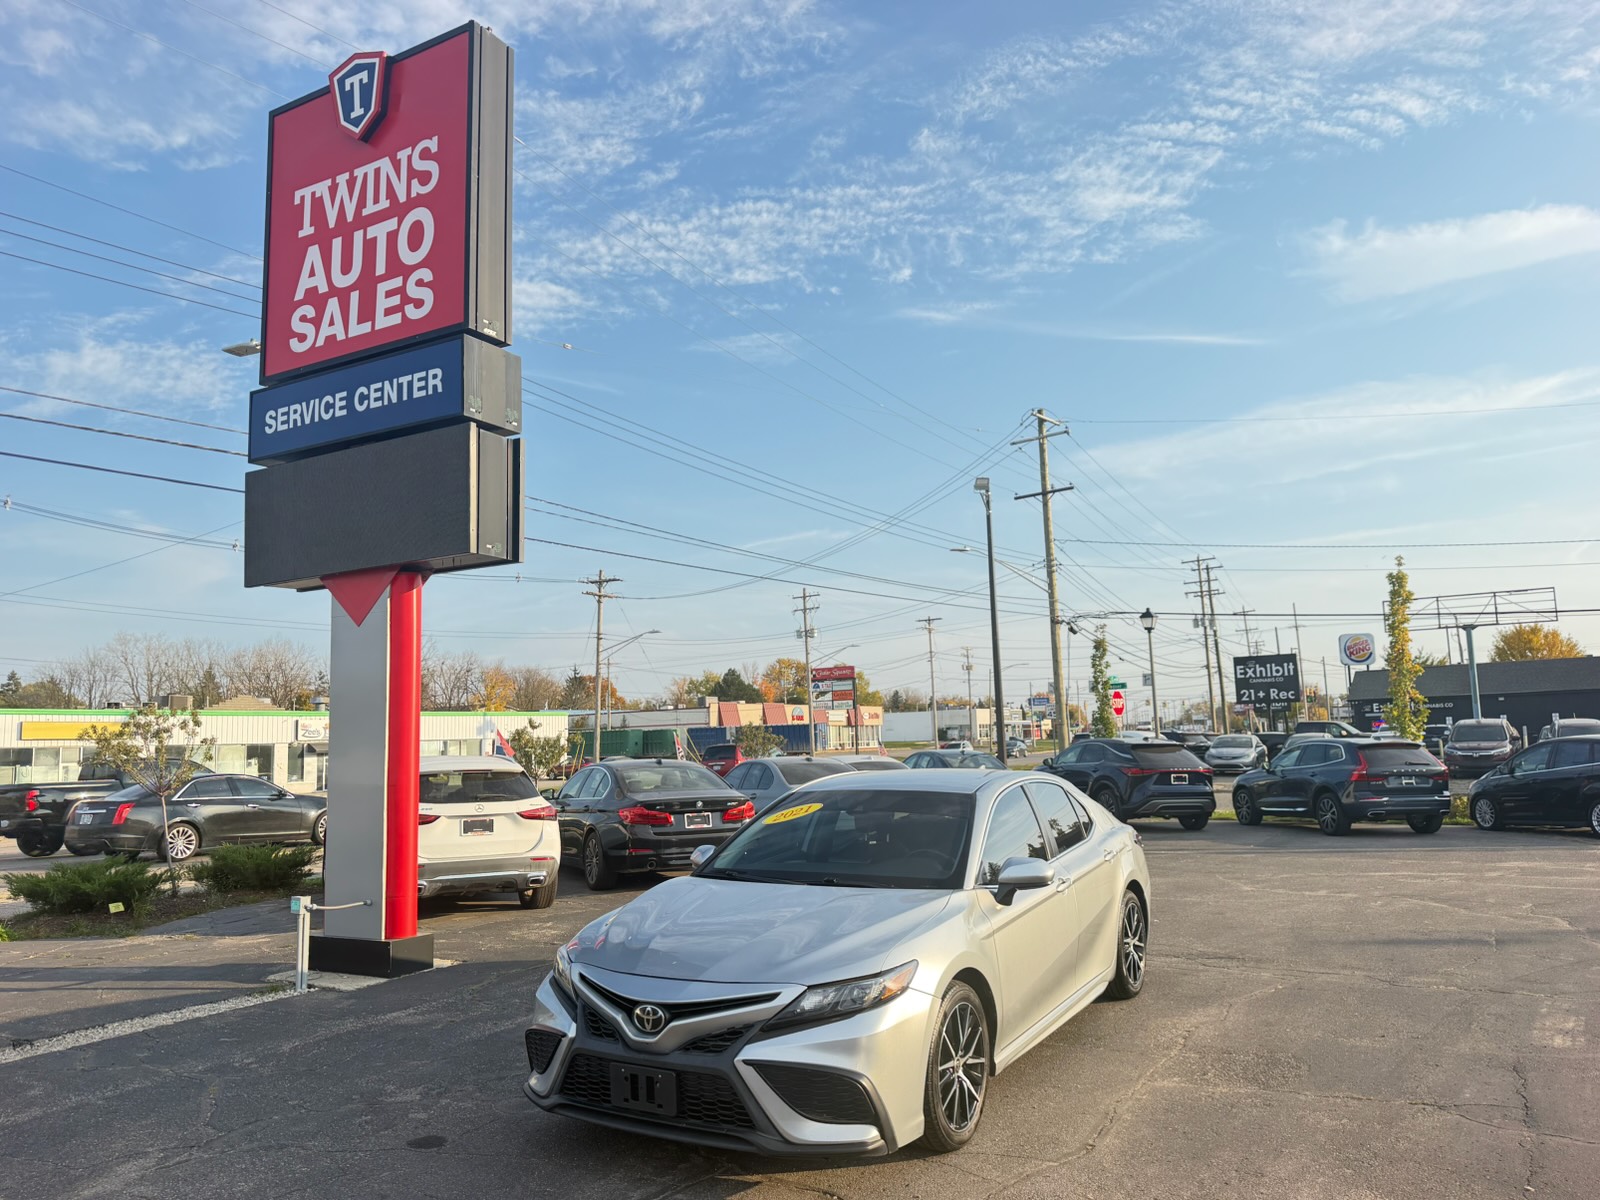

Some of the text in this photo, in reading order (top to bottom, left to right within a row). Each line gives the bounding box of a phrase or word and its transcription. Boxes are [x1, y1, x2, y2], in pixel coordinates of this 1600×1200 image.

[345, 70, 369, 119] T
[294, 135, 440, 238] TWINS
[293, 206, 435, 301] AUTO
[289, 267, 435, 353] SALES
[264, 367, 443, 434] SERVICE CENTER
[1347, 640, 1369, 651] BURGER
[1348, 644, 1371, 658] KING
[1236, 662, 1295, 678] Exhibit
[1240, 688, 1295, 701] 21+ Rec
[1112, 698, 1124, 709] STOP
[772, 805, 813, 822] 2021
